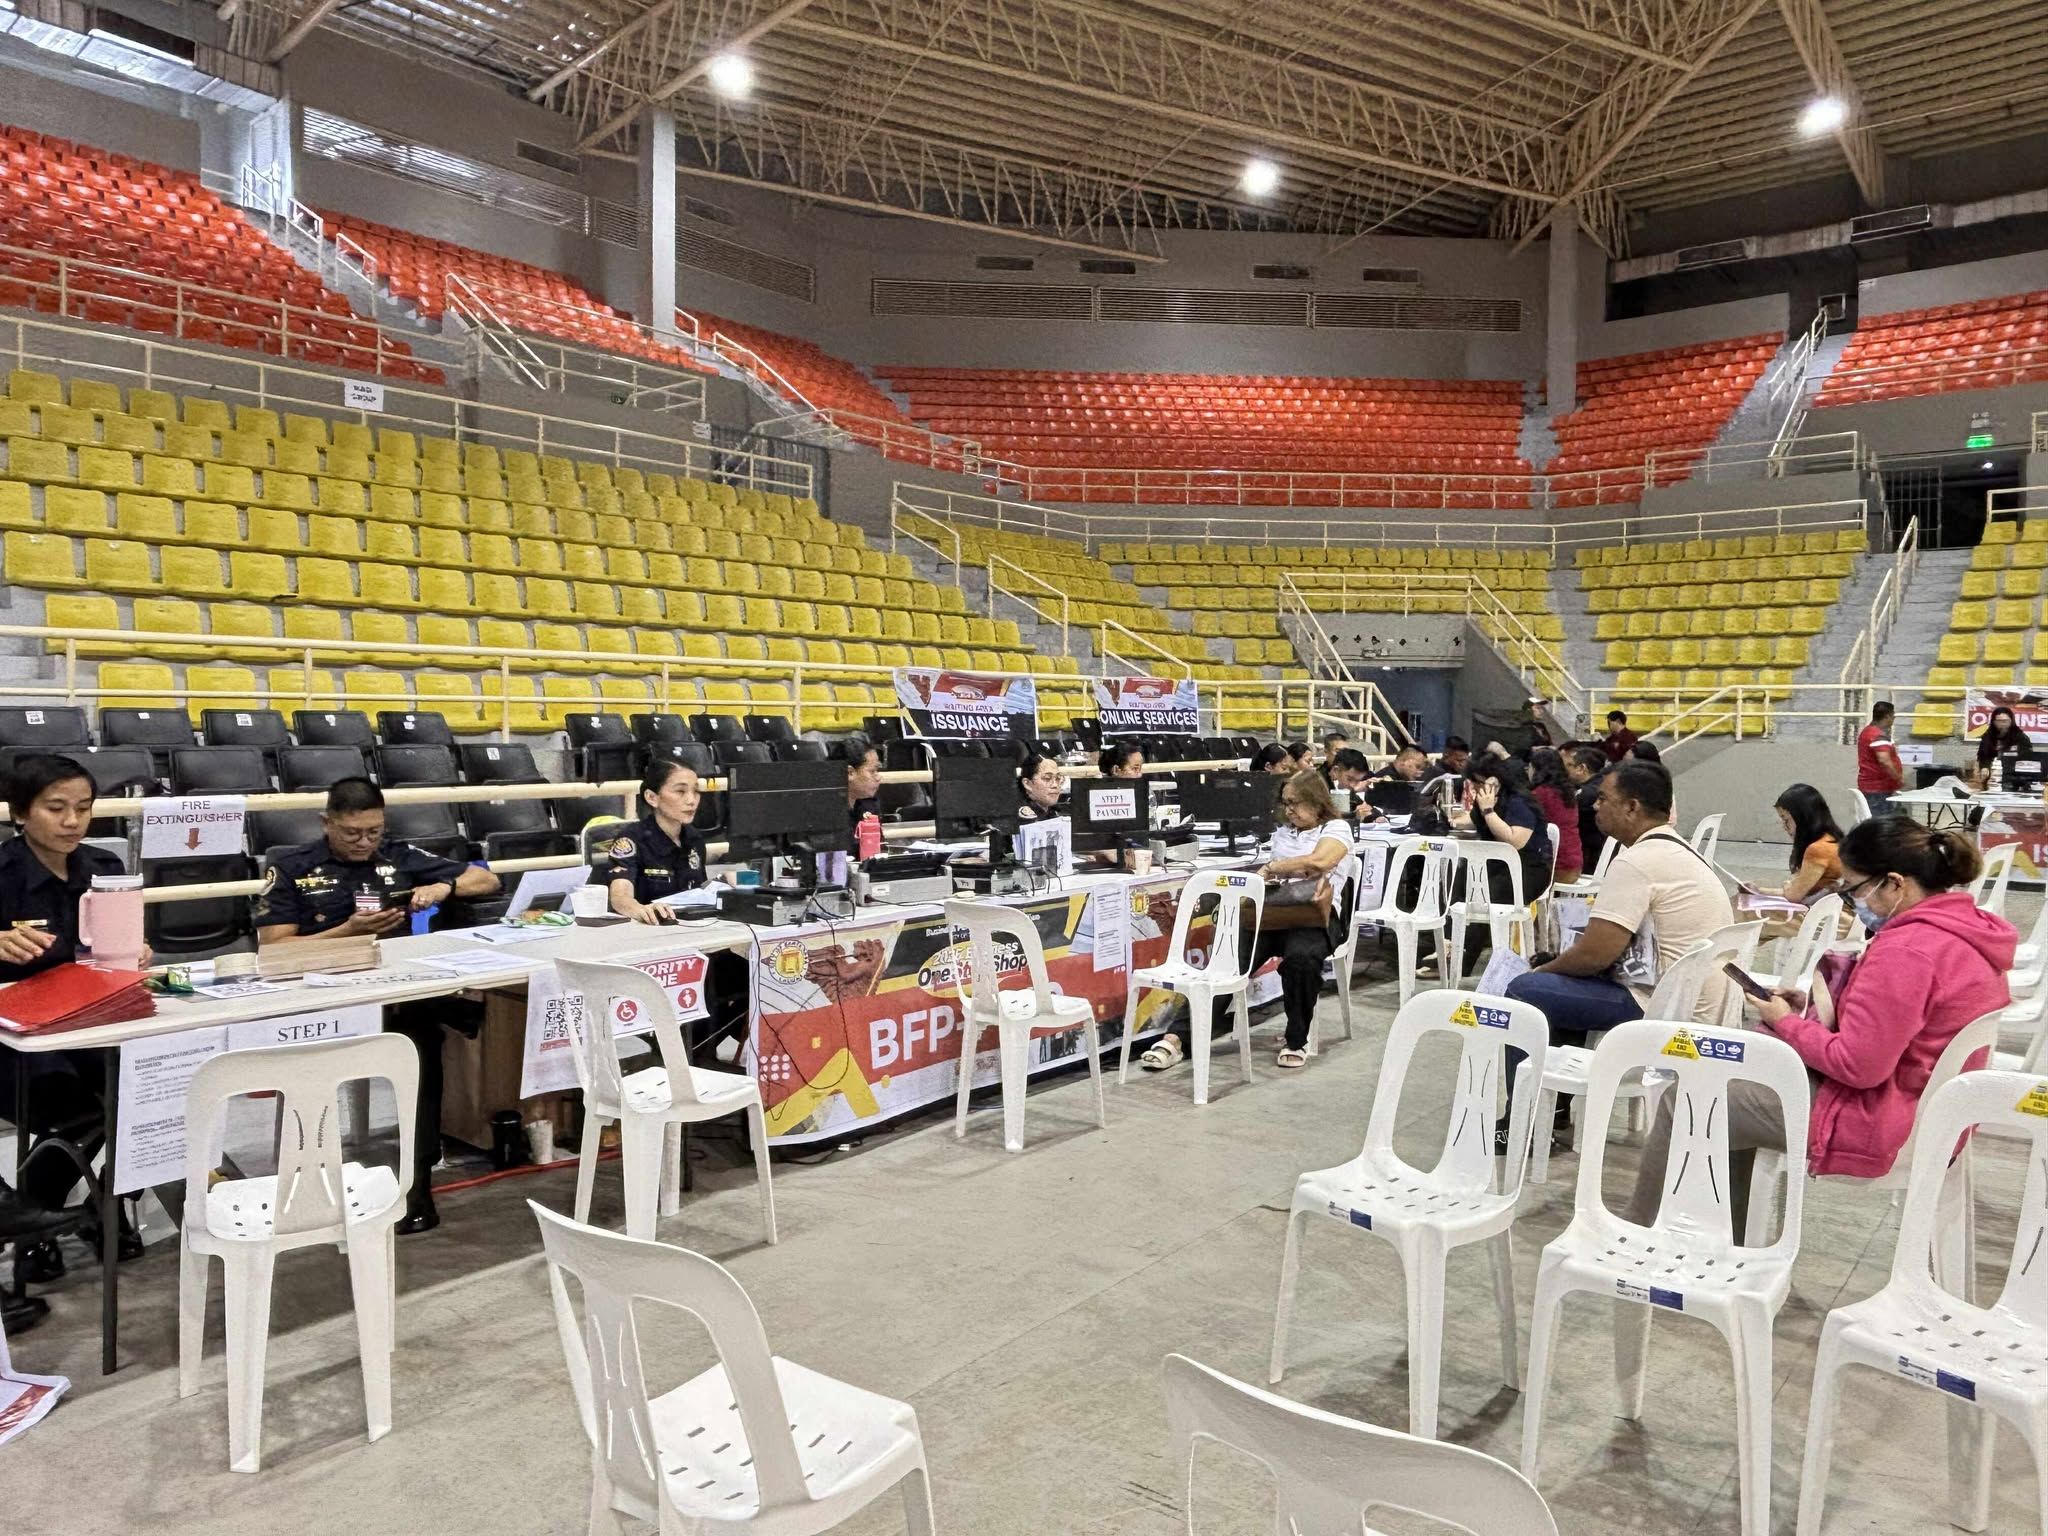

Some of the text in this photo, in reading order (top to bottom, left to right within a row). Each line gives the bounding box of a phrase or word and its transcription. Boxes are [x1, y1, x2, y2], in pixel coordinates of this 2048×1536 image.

[931, 713, 1011, 732] ISSUANCE
[1100, 710, 1197, 725] ONLINE SERVICES
[1971, 712, 2048, 728] OINE
[182, 800, 211, 810] FIRE
[1101, 795, 1119, 804] STEP
[146, 812, 243, 825] EXTINGUISHER
[1096, 808, 1129, 817] PAYMENT
[918, 966, 950, 987] One
[277, 1019, 340, 1042] STEP 1
